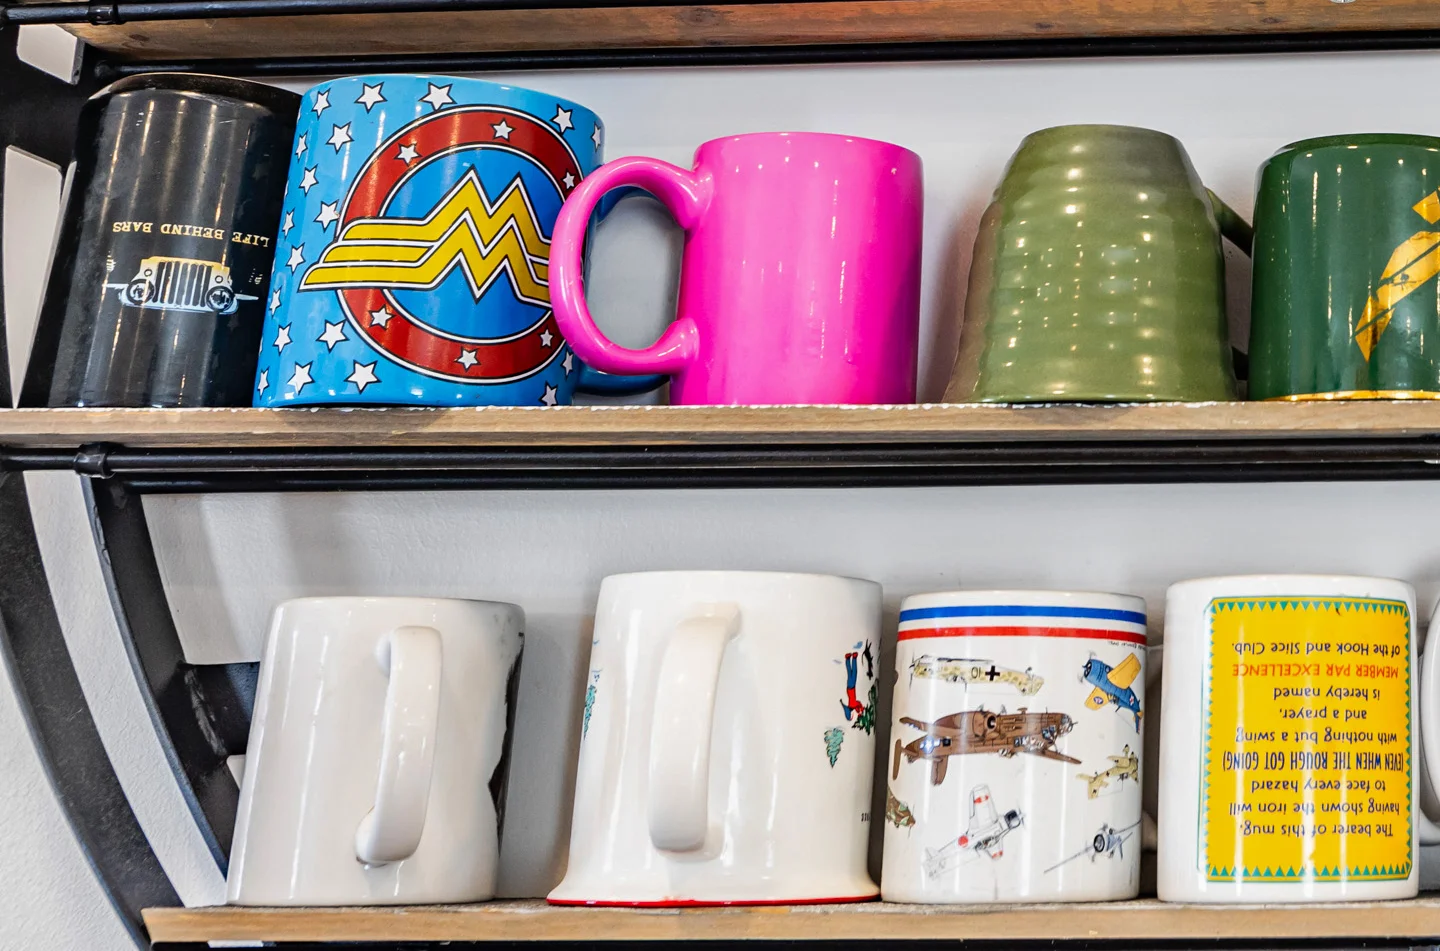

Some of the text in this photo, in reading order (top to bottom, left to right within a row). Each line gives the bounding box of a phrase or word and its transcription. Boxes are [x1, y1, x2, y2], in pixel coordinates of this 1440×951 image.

[112, 220, 269, 248] LIFE BEHIND BARS
[1231, 642, 1400, 658] of the Hook and Slice Club.
[1231, 663, 1399, 678] MEMBER PAR EXCELLENCE
[1273, 685, 1381, 701] is hereby named
[1332, 709, 1340, 719] a
[1344, 707, 1368, 722] and
[1235, 726, 1398, 744] with nothing but a swing
[1222, 750, 1404, 773] (EVEN WHEN THE ROUGH GOT GOING)
[1251, 777, 1386, 793] to face every hazard
[1229, 797, 1400, 816] having shown the iron will
[1281, 822, 1306, 838] this
[1311, 824, 1327, 838] of
[1331, 823, 1371, 838] bearer
[1375, 823, 1394, 838] The
